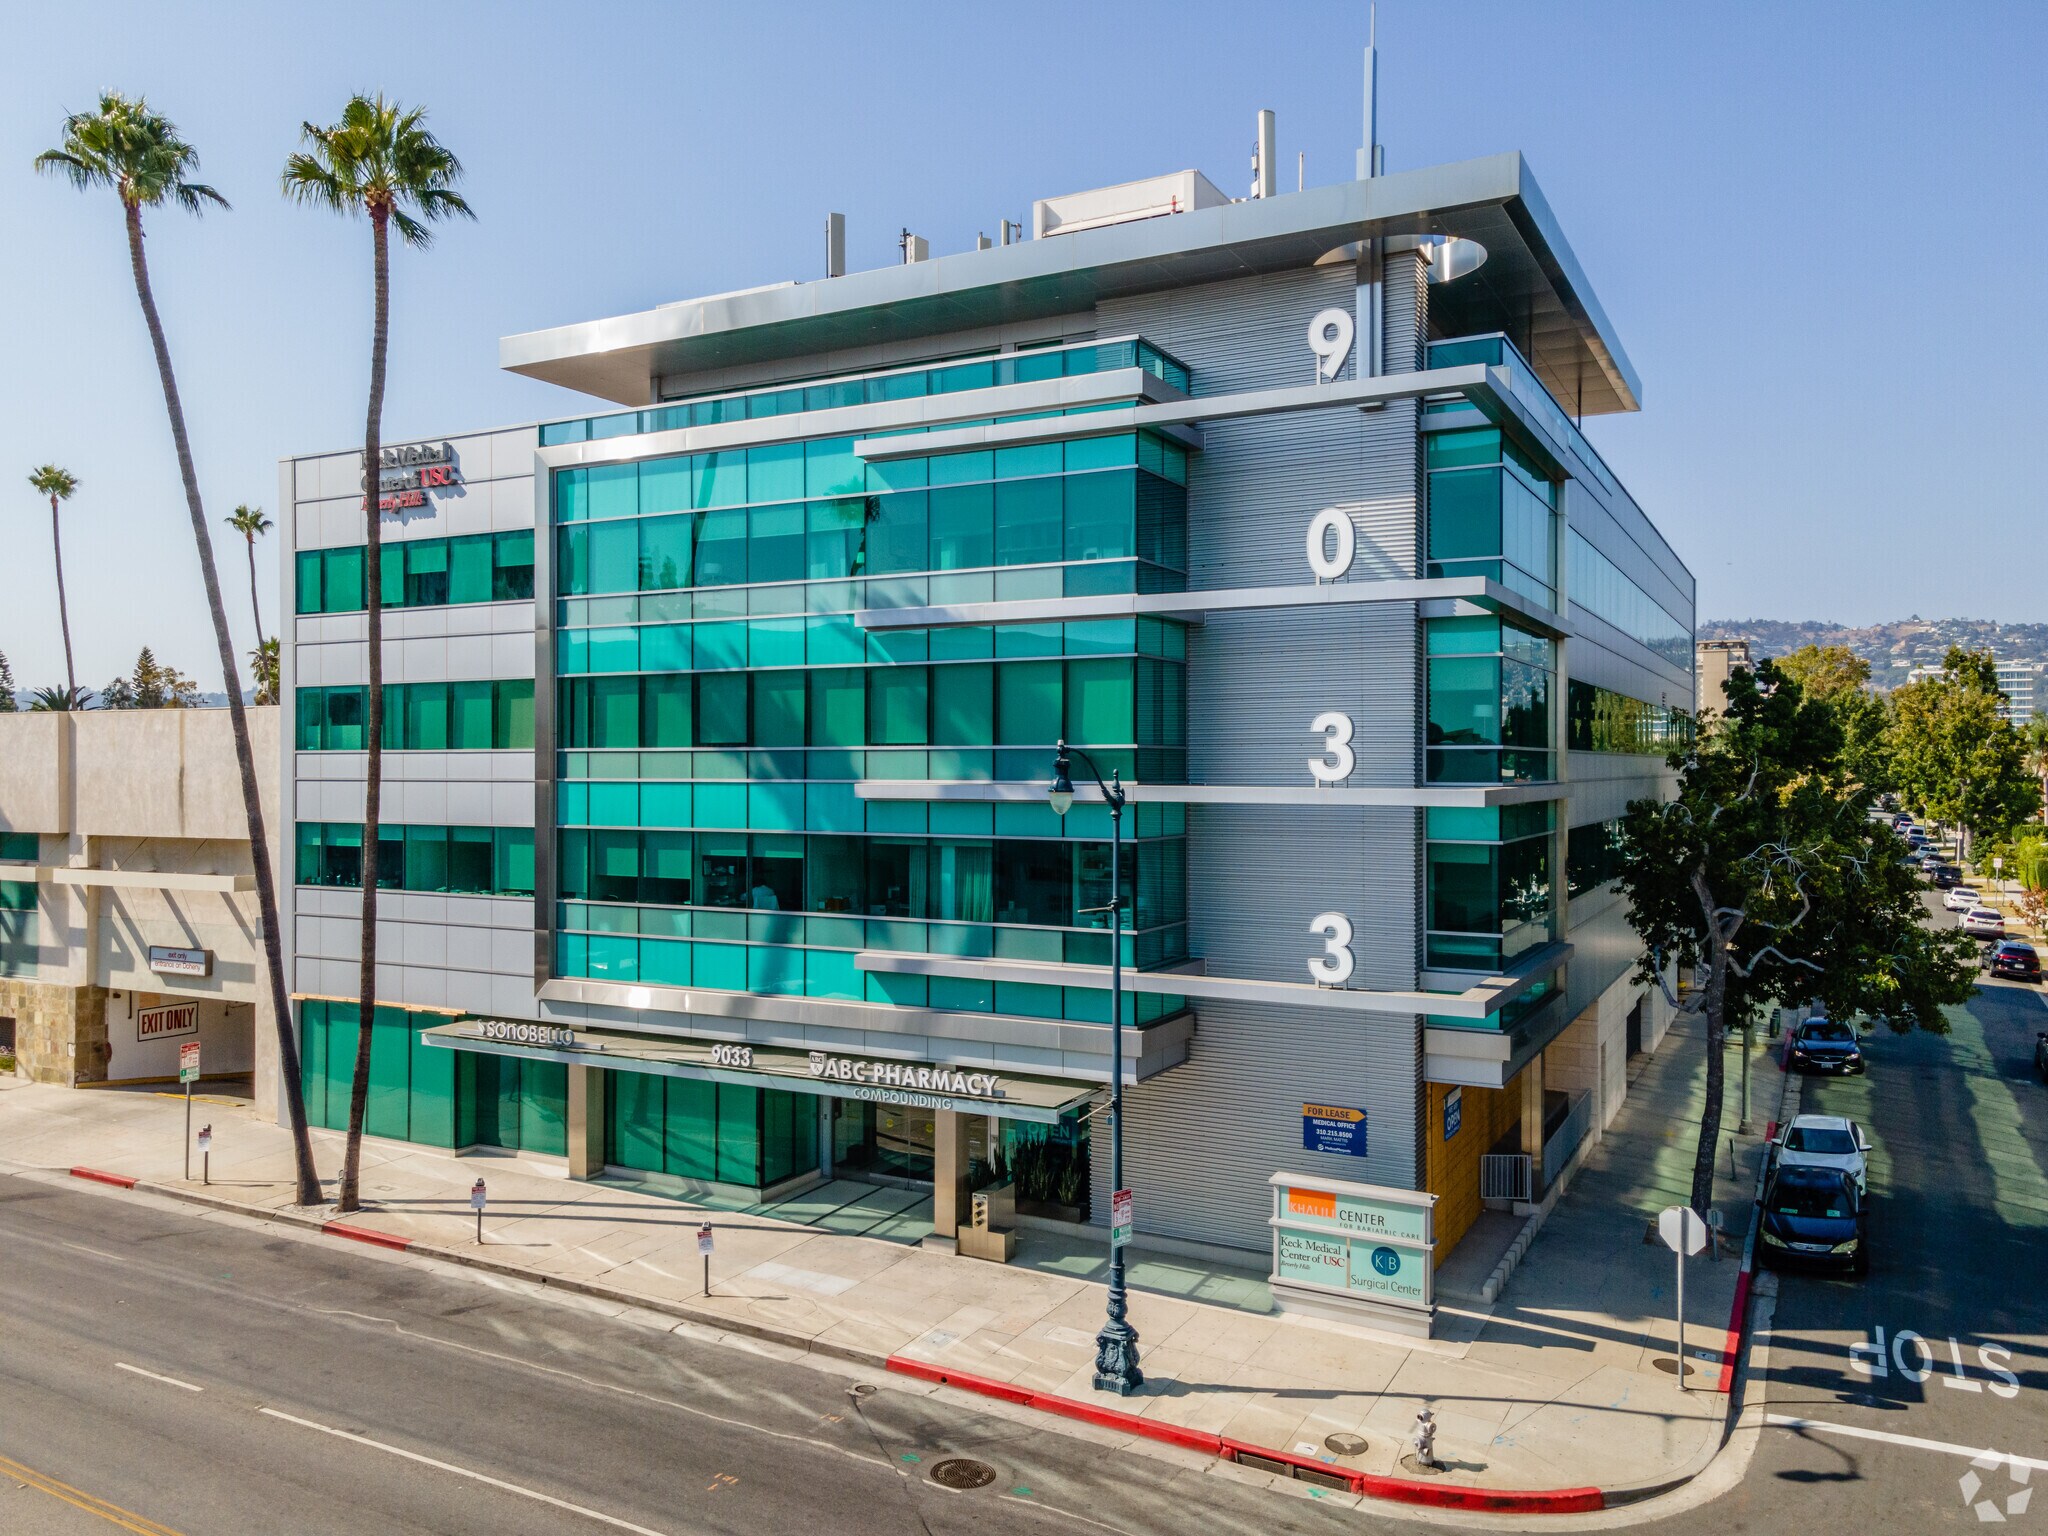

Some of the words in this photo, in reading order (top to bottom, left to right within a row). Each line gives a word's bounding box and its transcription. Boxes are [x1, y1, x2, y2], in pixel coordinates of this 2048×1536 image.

[421, 465, 453, 487] USC
[399, 489, 423, 508] Hills
[142, 1012, 164, 1034] EXIT
[166, 1007, 194, 1030] ONLY
[711, 1044, 753, 1067] 9033
[824, 1058, 868, 1082] ABC
[873, 1062, 1000, 1097] PHARMACY
[853, 1087, 952, 1110] COMPOUNDING
[1308, 1107, 1323, 1116] FOR
[1325, 1109, 1351, 1119] LEASE
[1312, 1119, 1336, 1127] MEDICAL
[1337, 1122, 1356, 1130] OFFICE
[1290, 1202, 1336, 1219] KHALILI
[1340, 1209, 1385, 1226] CENTER
[1357, 1225, 1397, 1236] BARIATRIC
[1400, 1231, 1420, 1240] CARE
[1280, 1236, 1303, 1249] Keck
[1305, 1240, 1341, 1255] Medical
[1280, 1248, 1310, 1262] Center
[1311, 1254, 1322, 1263] of
[1323, 1254, 1346, 1268] USC
[1281, 1260, 1298, 1269] Beverly
[1350, 1274, 1389, 1291] Surgical
[1391, 1281, 1422, 1296] Center
[1850, 1325, 2020, 1399] STOP
